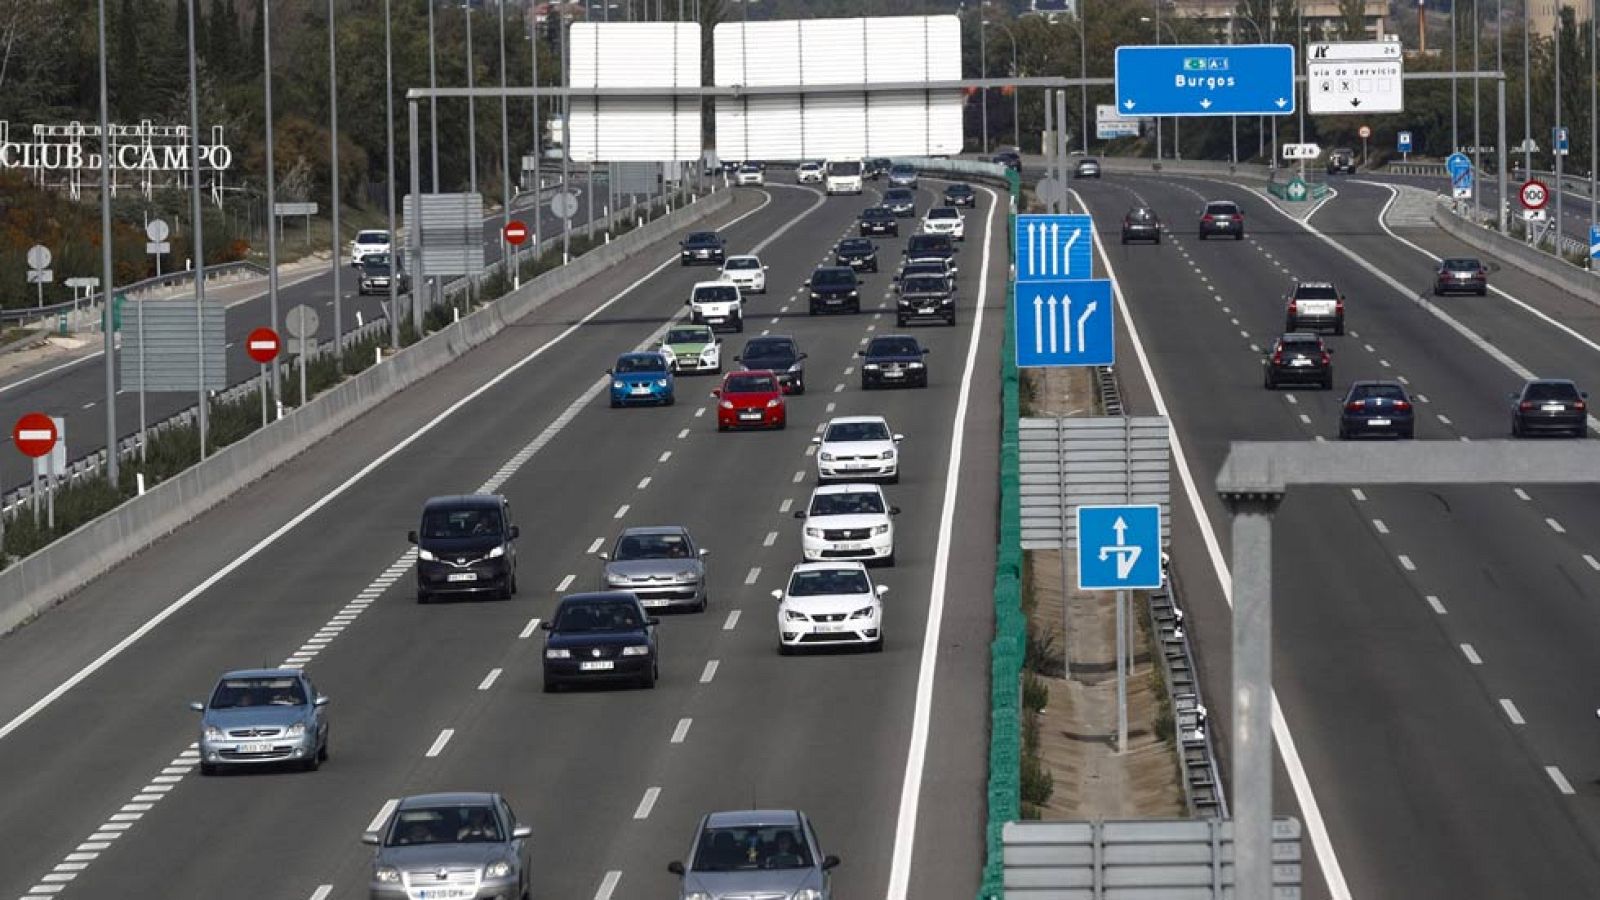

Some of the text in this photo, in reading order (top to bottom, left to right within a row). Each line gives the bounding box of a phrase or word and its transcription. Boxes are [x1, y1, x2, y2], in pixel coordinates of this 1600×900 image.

[1354, 68, 1396, 76] servicio
[1175, 74, 1235, 90] Burgos
[0, 143, 83, 169] CLUB
[118, 144, 233, 170] CAMPO
[1526, 190, 1544, 200] 100
